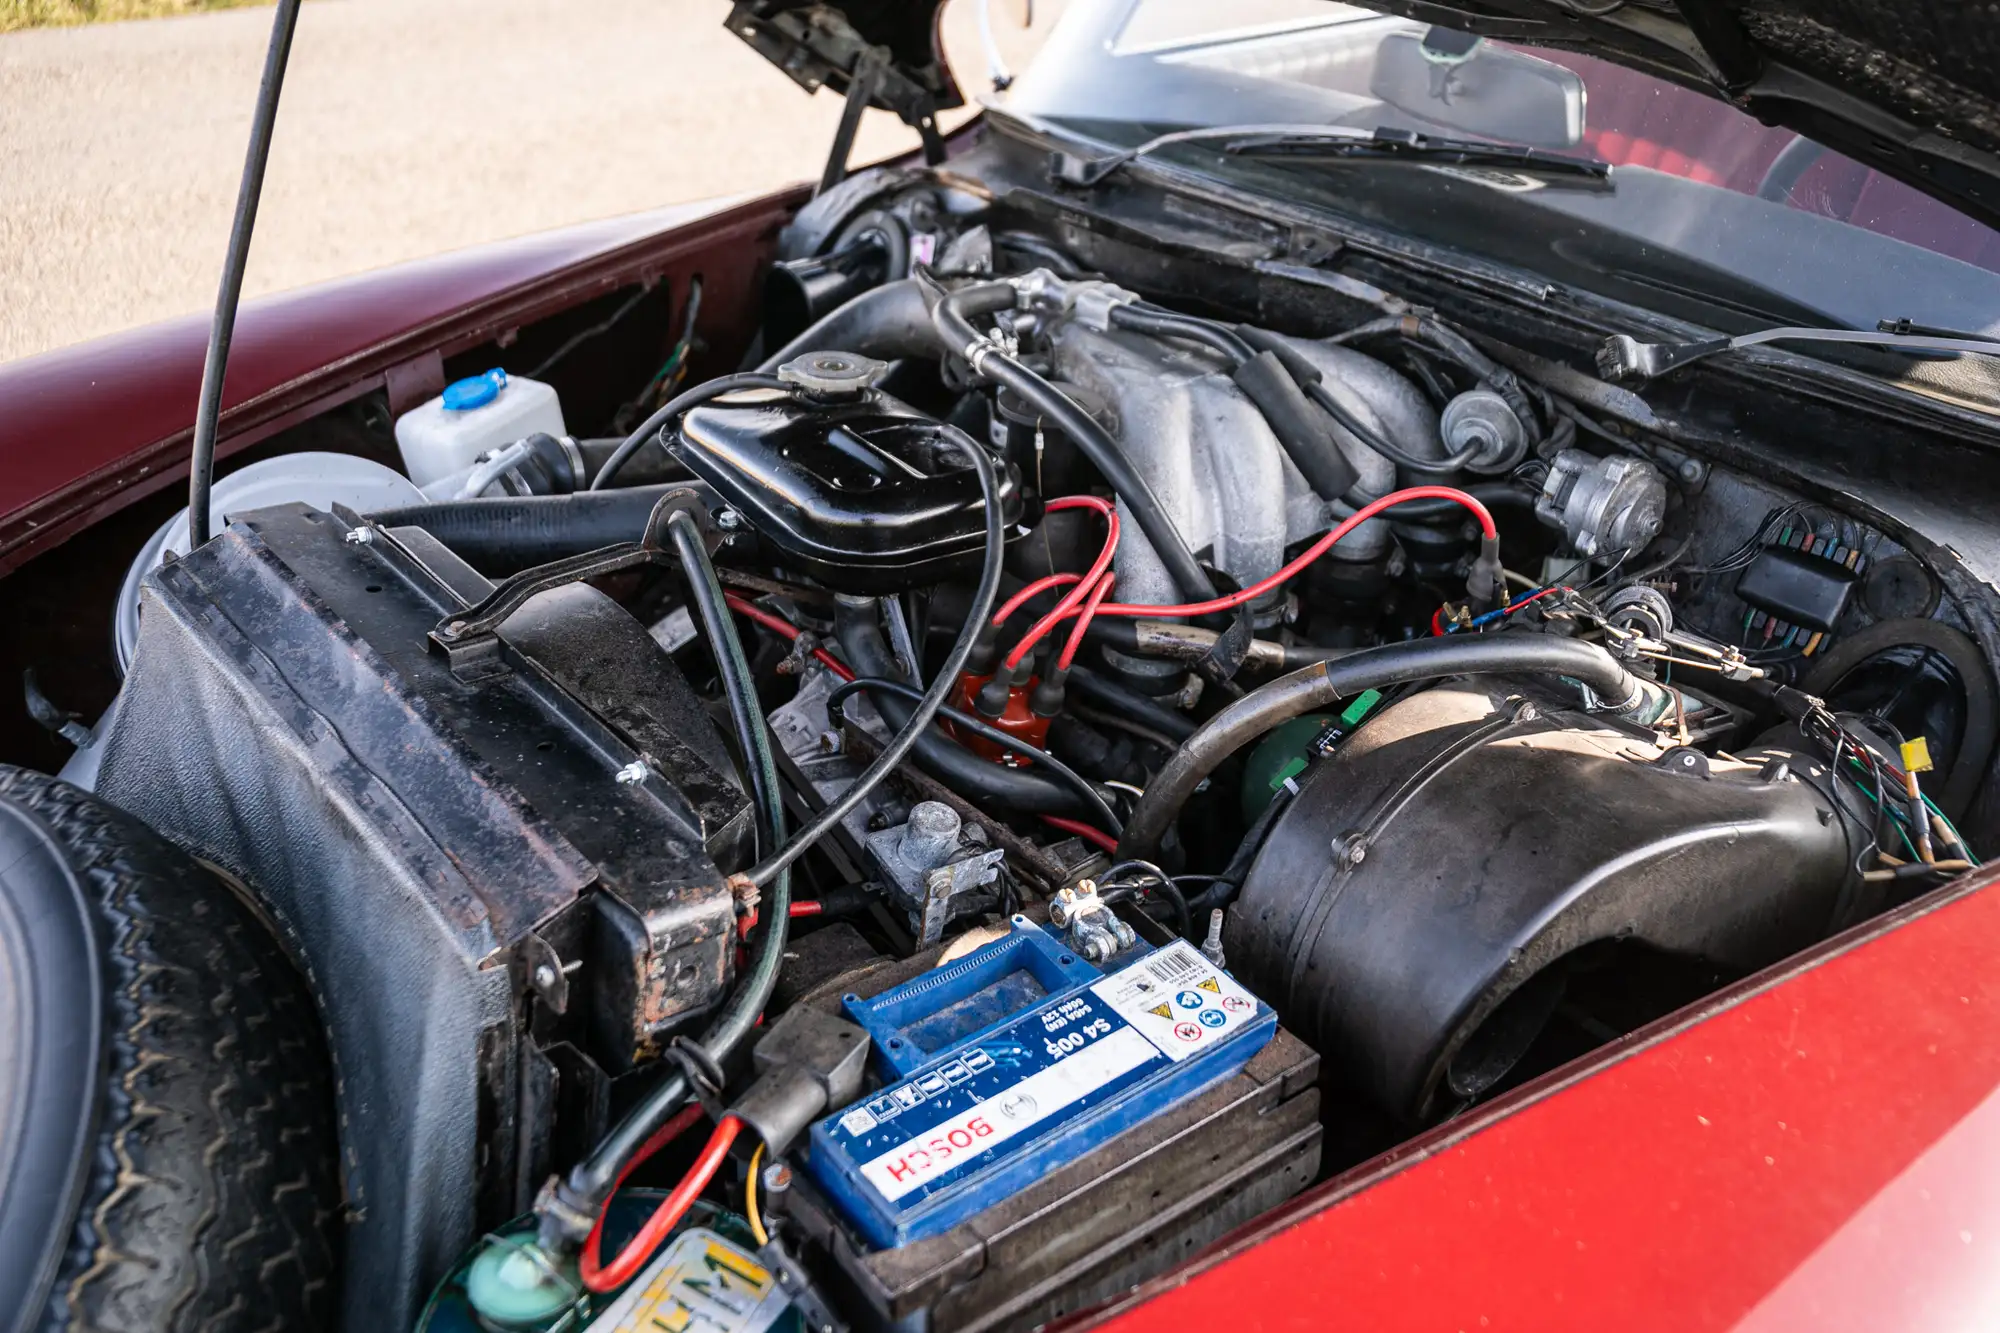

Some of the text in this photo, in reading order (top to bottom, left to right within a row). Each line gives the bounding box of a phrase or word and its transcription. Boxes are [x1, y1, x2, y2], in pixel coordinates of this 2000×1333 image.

[1041, 998, 1084, 1025] 60Ah 12V
[1065, 1004, 1092, 1021] 540A
[1046, 1018, 1111, 1060] S4 005
[886, 1116, 994, 1182] BOSCH
